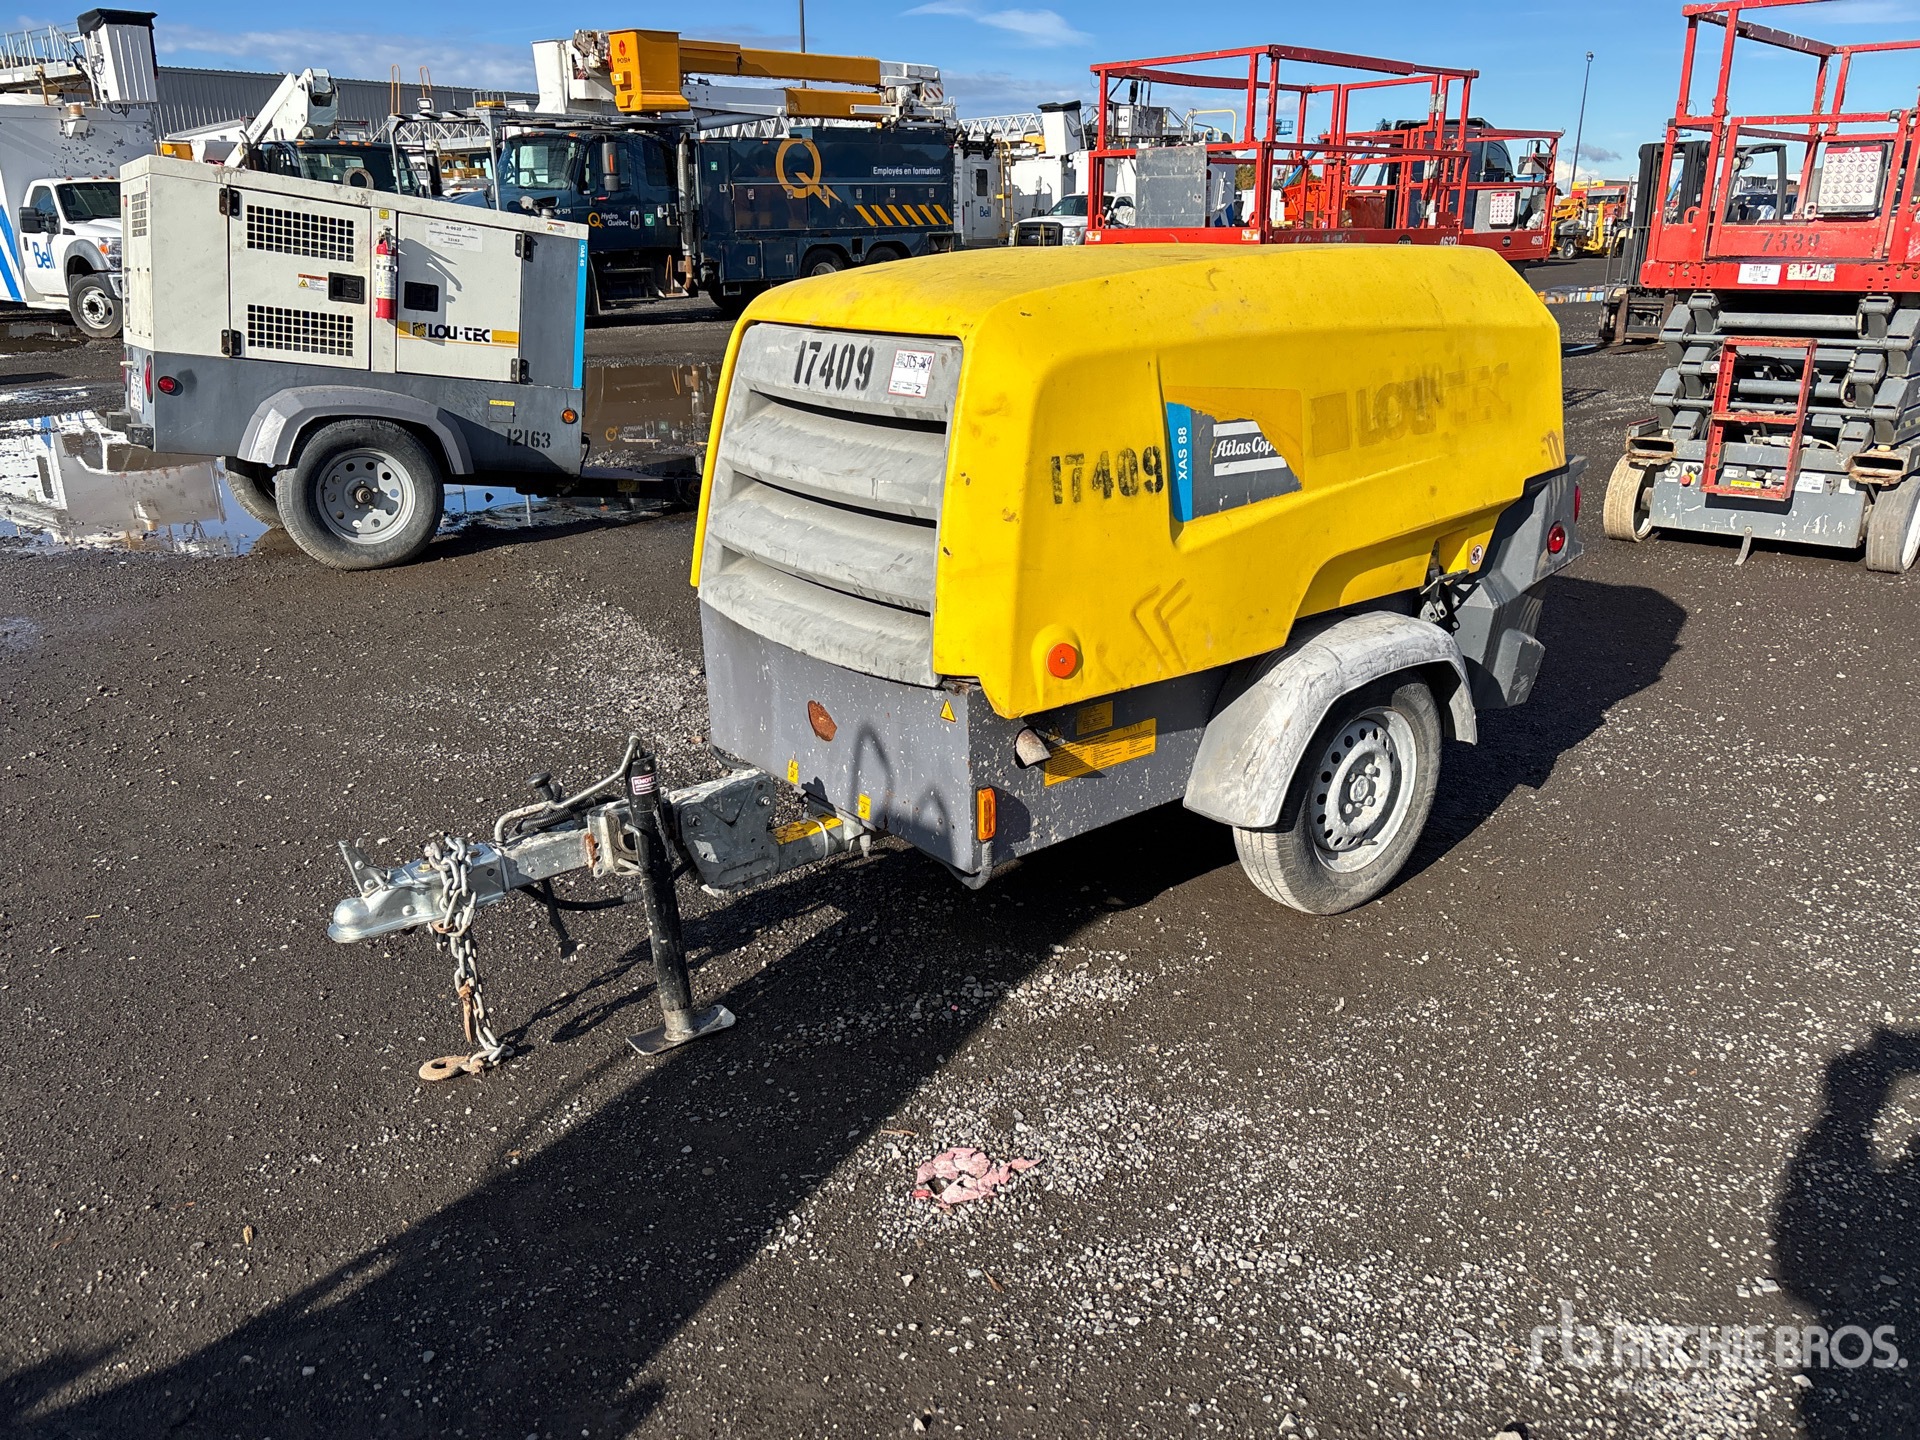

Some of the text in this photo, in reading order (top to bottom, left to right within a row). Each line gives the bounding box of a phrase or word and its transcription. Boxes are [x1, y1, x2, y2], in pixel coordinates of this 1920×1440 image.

[873, 166, 902, 176] Employés
[912, 166, 941, 175] formation
[980, 206, 991, 217] Bell
[32, 241, 56, 269] Bell
[794, 340, 875, 391] 17409
[507, 428, 551, 449] 12163
[1214, 439, 1251, 458] Atlas
[1177, 426, 1188, 480] XAS 88
[1050, 445, 1164, 505] 17409
